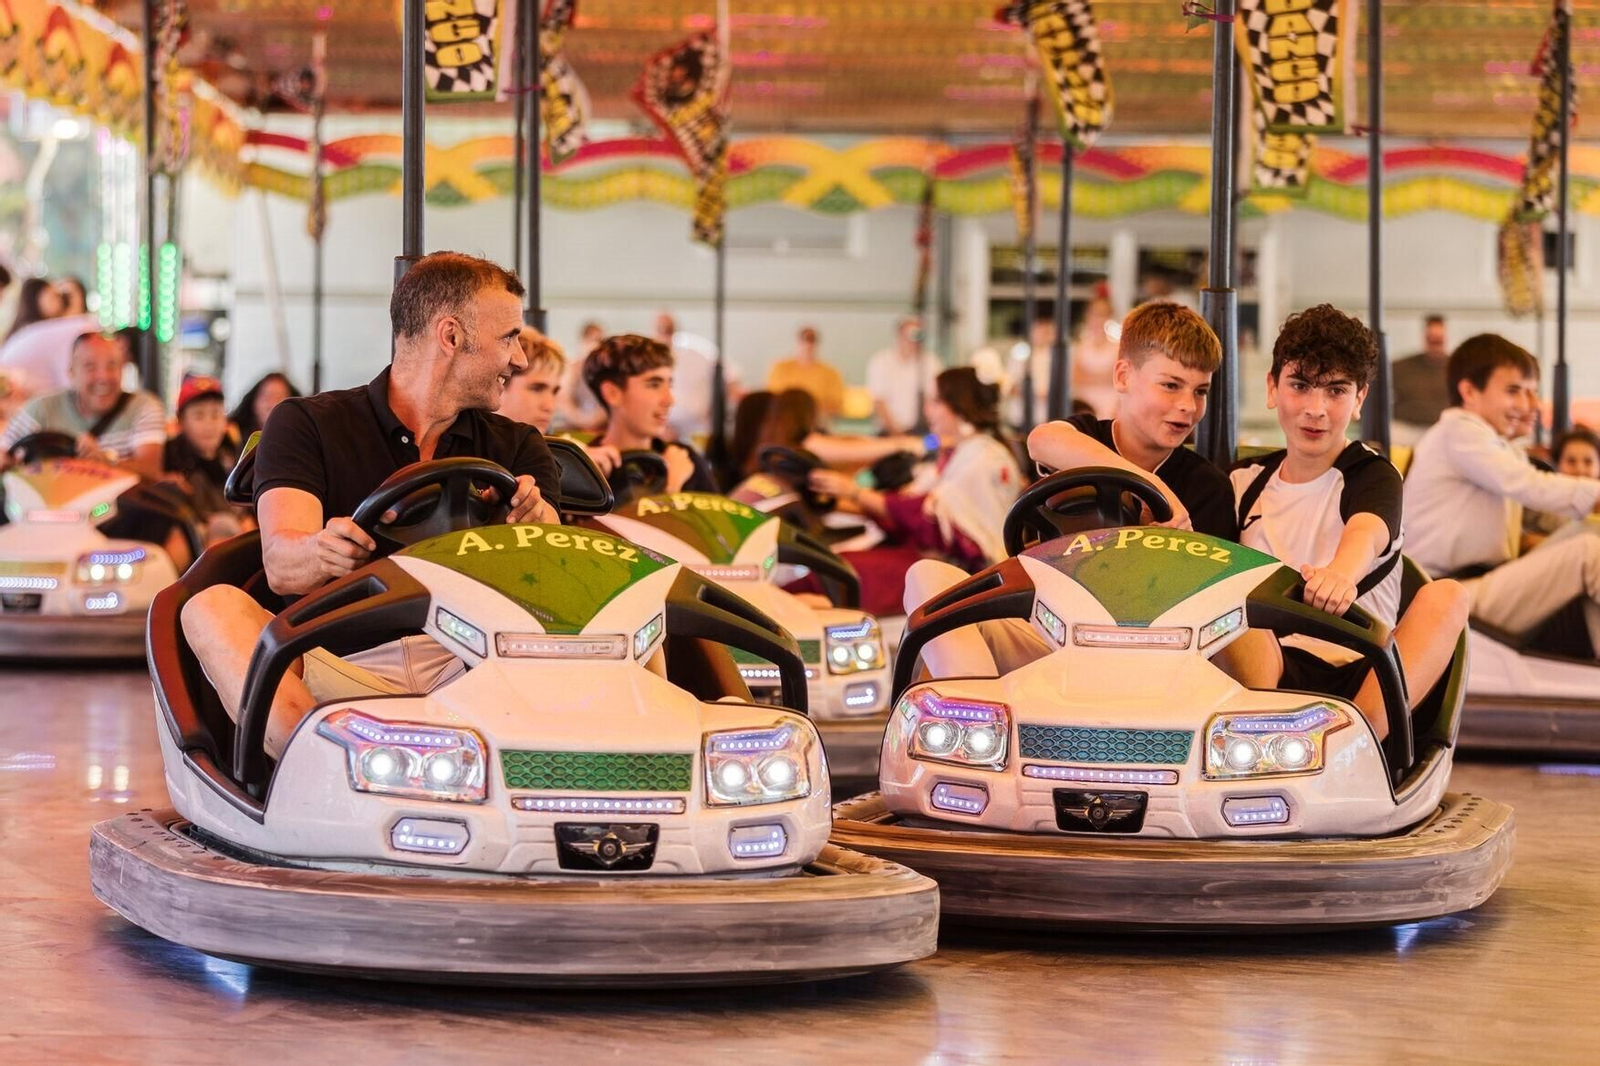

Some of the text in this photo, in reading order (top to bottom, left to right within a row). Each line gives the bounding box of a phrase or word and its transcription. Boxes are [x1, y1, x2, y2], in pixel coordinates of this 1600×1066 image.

[637, 493, 754, 519] A. Perez
[456, 525, 640, 563] A. Perez
[1063, 529, 1232, 563] A. Perez
